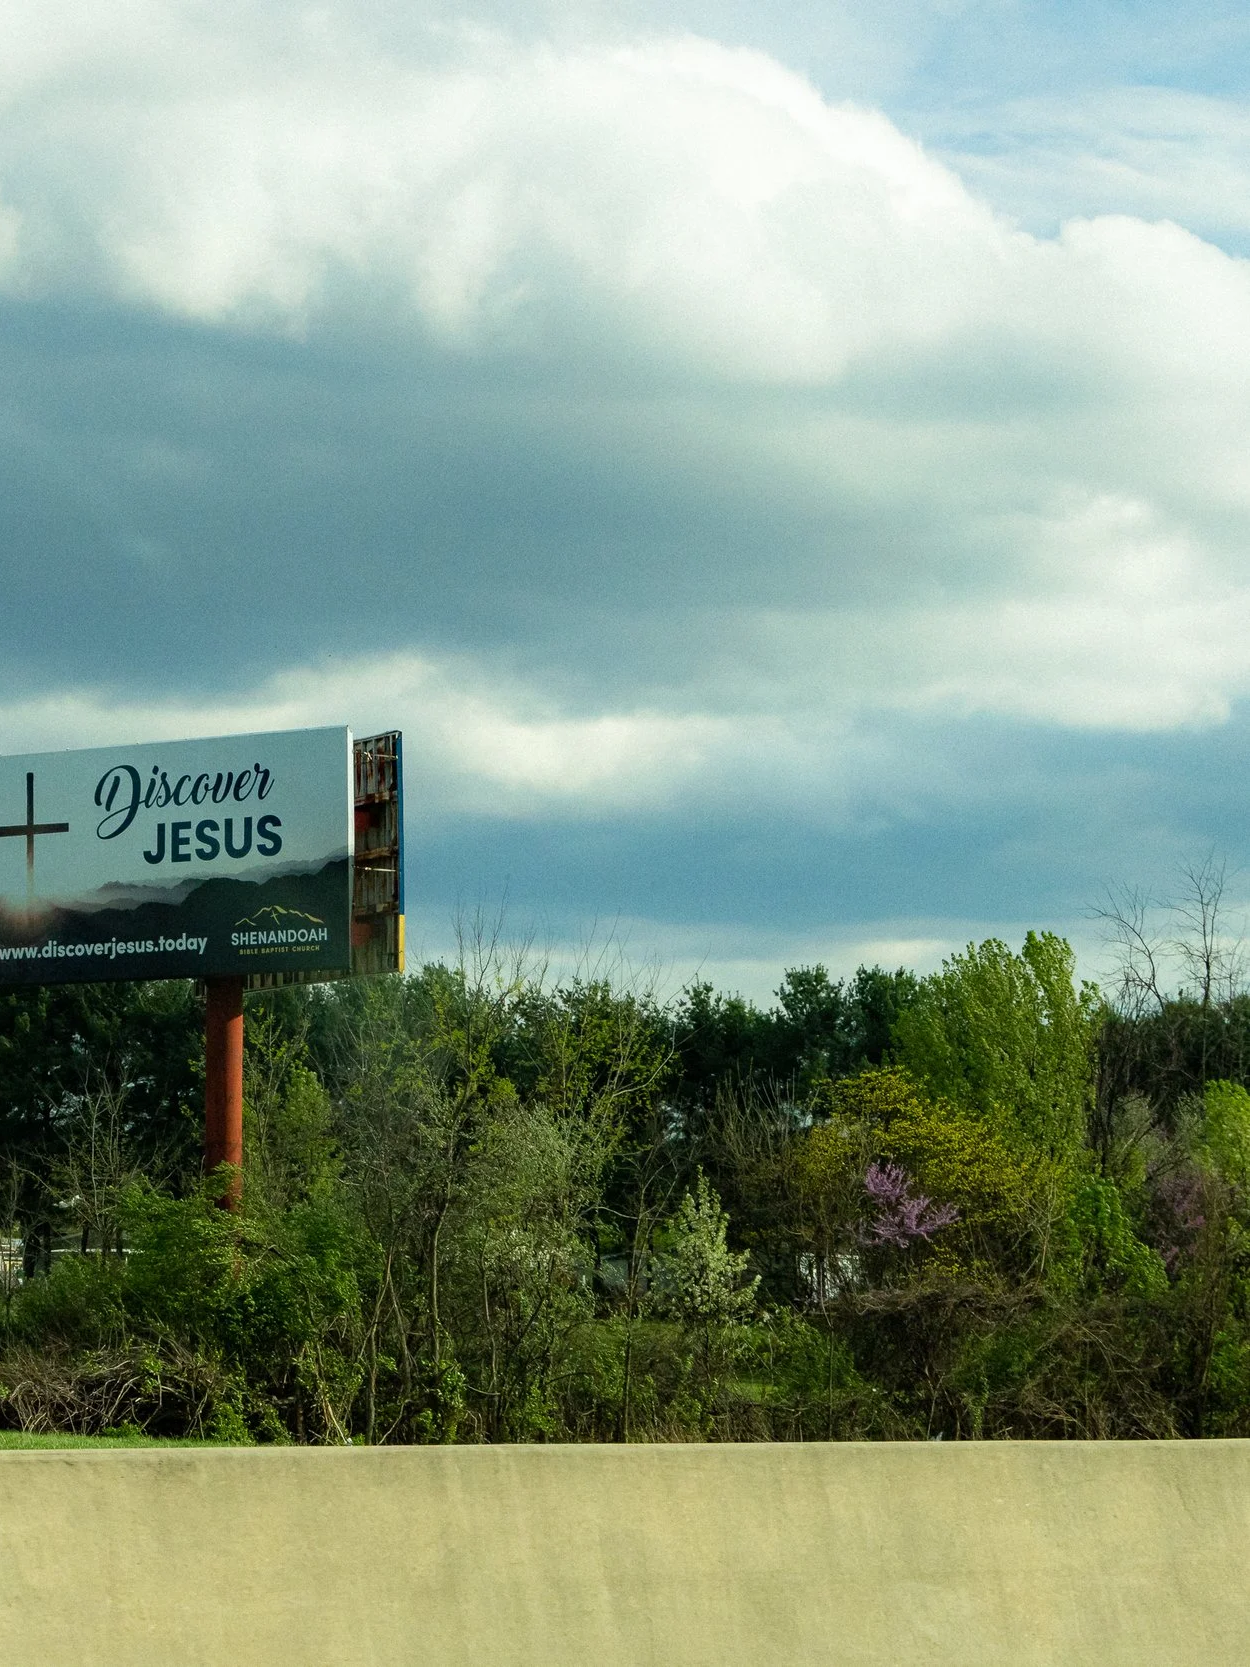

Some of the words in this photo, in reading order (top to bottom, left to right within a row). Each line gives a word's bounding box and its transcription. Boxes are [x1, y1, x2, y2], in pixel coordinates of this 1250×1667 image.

[94, 762, 275, 840] Discover
[143, 814, 282, 864] JESUS
[231, 927, 328, 946] SHENANDOAH
[261, 946, 289, 954] BAPTIST
